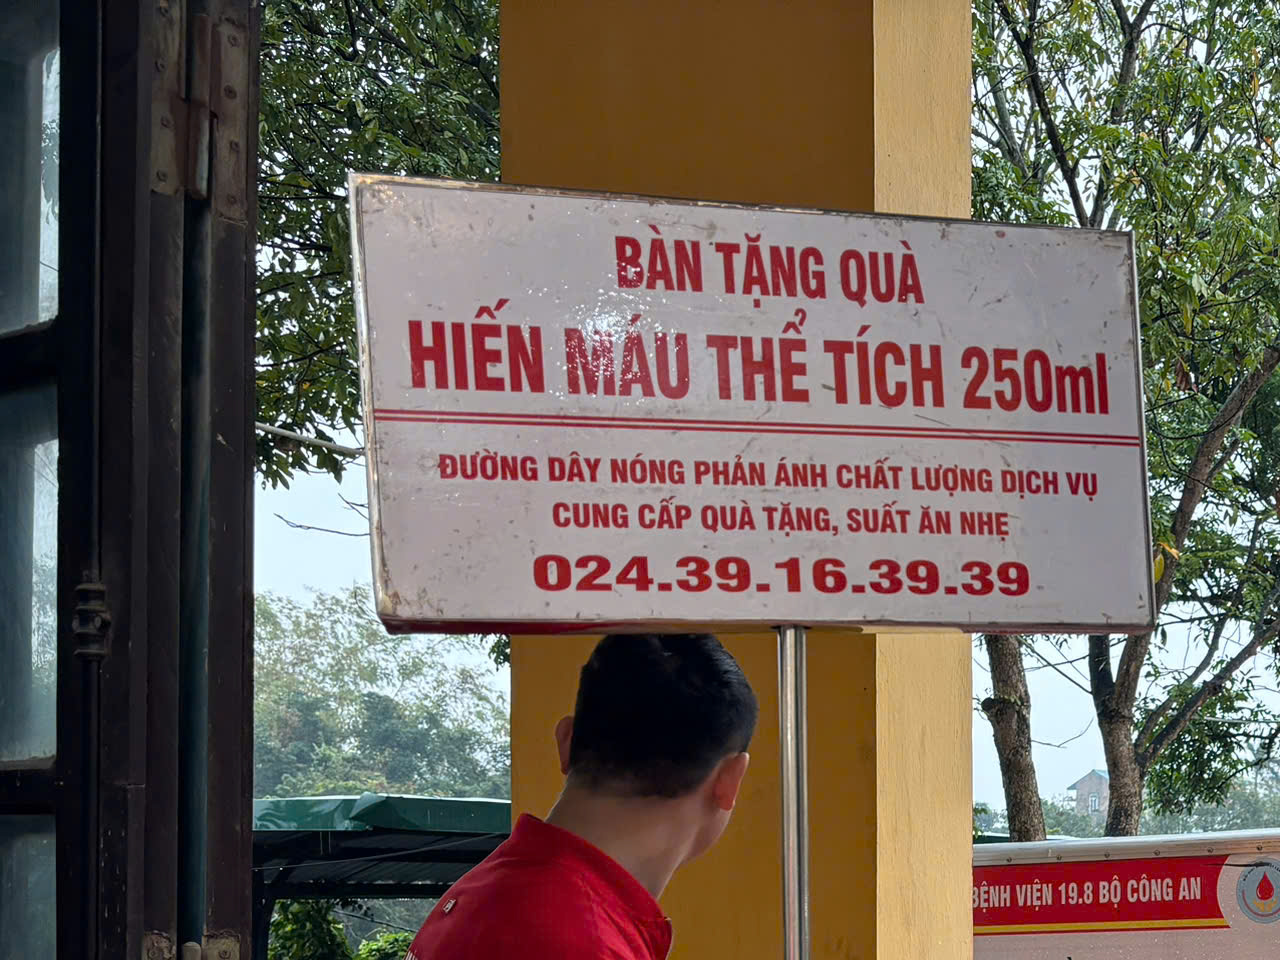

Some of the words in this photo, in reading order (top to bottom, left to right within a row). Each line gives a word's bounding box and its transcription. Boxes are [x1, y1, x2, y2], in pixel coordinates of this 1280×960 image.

[616, 225, 703, 293] BÀN
[715, 233, 827, 308] TẶNG
[839, 240, 925, 306] QUÀ
[408, 298, 545, 394] HIẾN
[564, 314, 690, 401] MÁU
[707, 308, 810, 403] THỂ
[823, 324, 944, 408] TÍCH
[961, 346, 1110, 415] 250ml
[437, 449, 539, 482] ĐƯỜNG
[548, 451, 601, 483] DÂY
[610, 453, 686, 485] NÓNG
[694, 455, 766, 486] PHẢN
[774, 457, 828, 488] ÁNH
[836, 457, 903, 490] CHẤT
[911, 464, 993, 497] LƯỢNG
[1001, 469, 1059, 499] DỊCH
[1065, 472, 1098, 502] VỤ
[553, 502, 630, 529] CUNG
[638, 495, 692, 530] CẤP
[701, 500, 756, 533] QUÀ
[762, 502, 839, 537] TẶNG,
[846, 501, 911, 534] SUẤT
[918, 505, 952, 535] ĂN
[960, 512, 1010, 542] NHẸ
[533, 554, 1031, 597] 024.39.16.39.39
[973, 880, 1011, 913] BỆNH
[1016, 878, 1053, 911] VIỆN
[1058, 882, 1094, 905] 19.8
[1100, 875, 1121, 908] BỘ
[1127, 874, 1174, 902] CÔNG
[1179, 877, 1201, 901] AN
